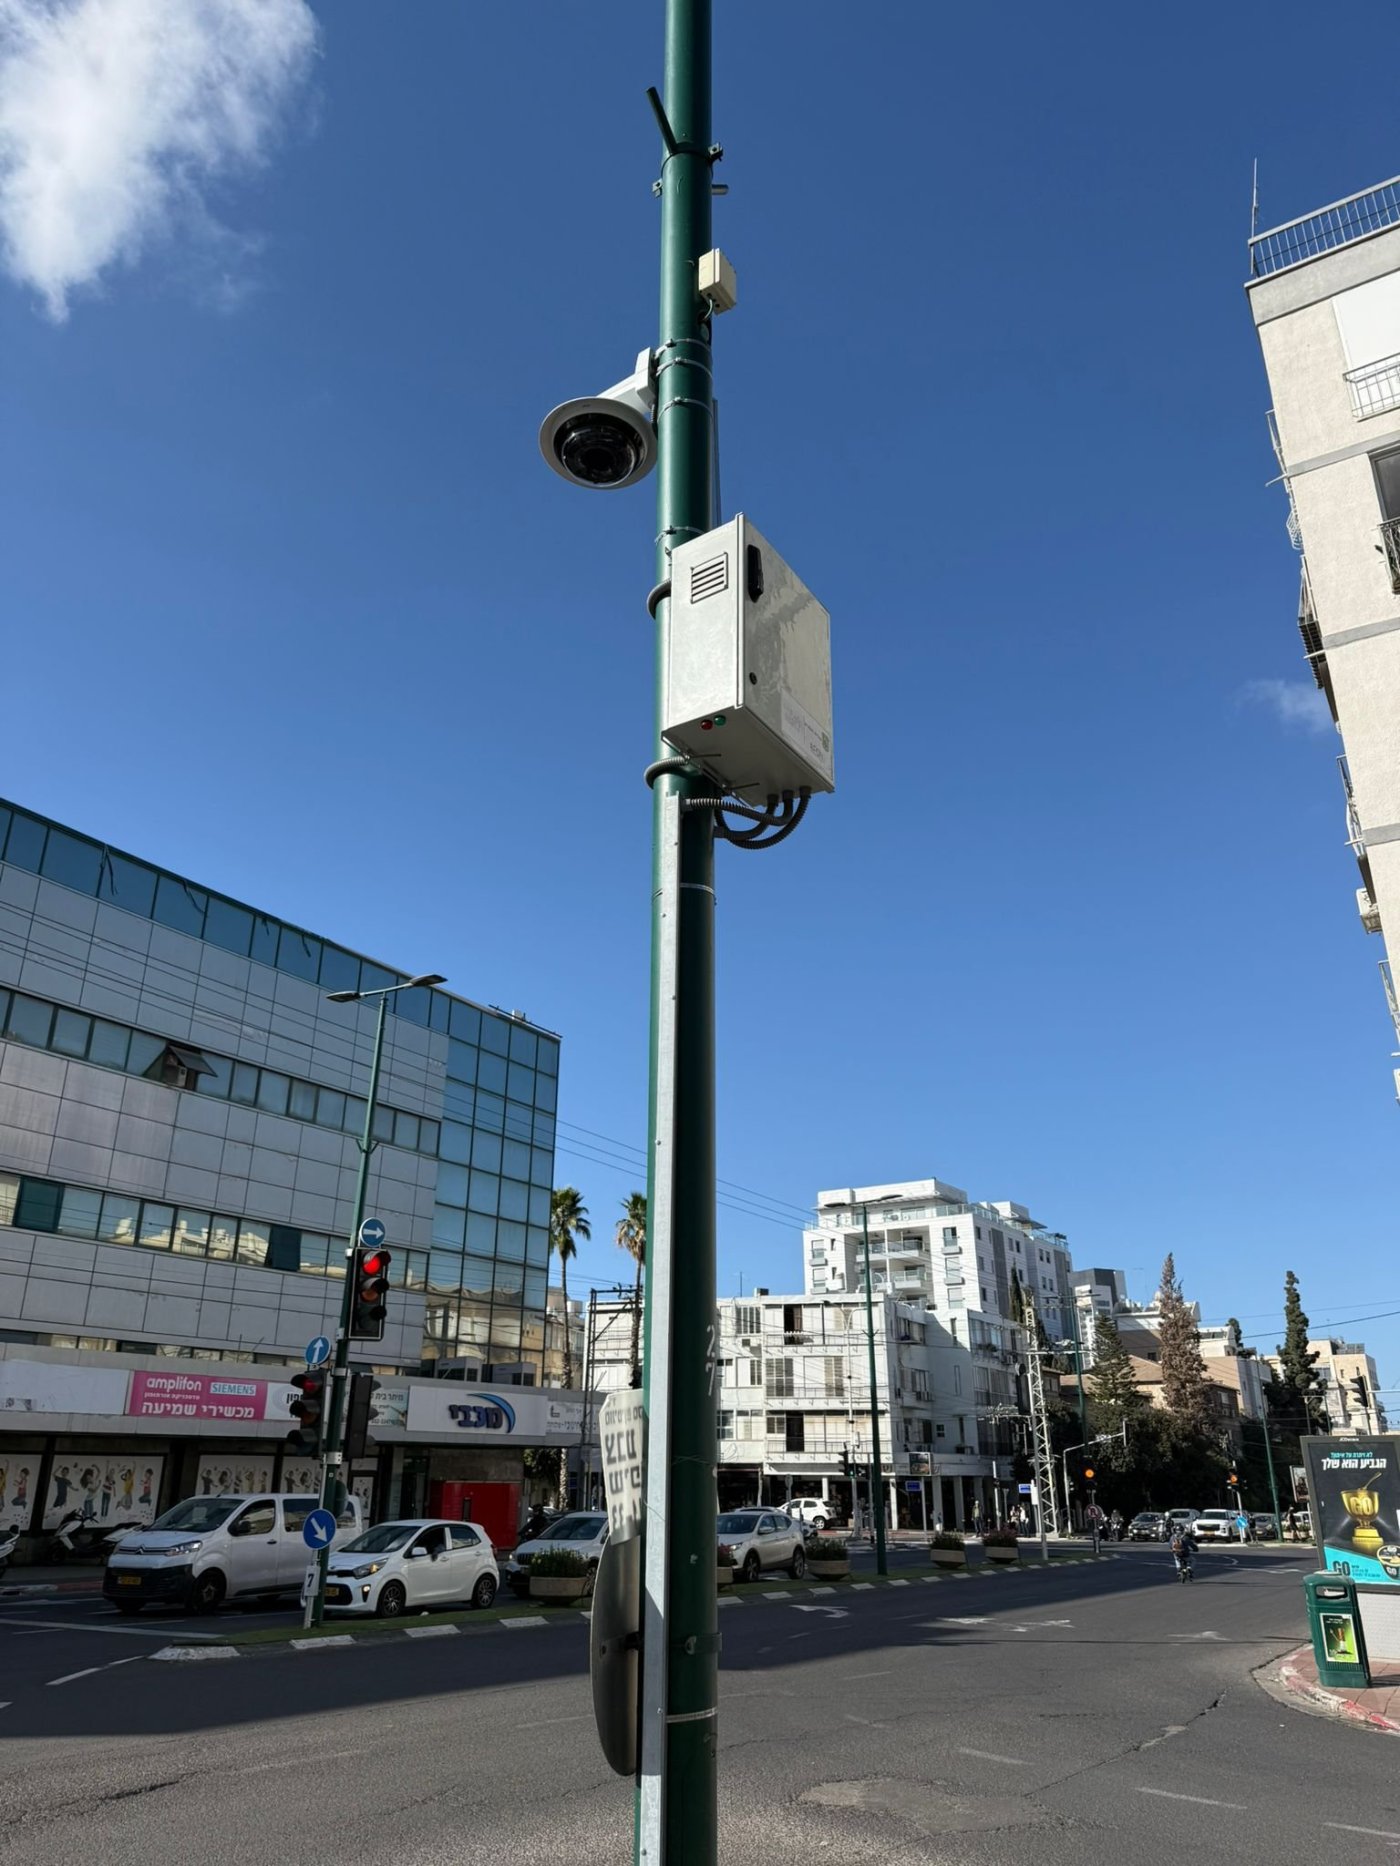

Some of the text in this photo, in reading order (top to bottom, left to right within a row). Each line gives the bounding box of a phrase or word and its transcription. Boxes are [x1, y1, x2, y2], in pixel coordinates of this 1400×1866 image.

[146, 1376, 202, 1393] amplifon
[211, 1383, 255, 1395] SIEMENS
[141, 1402, 255, 1418] מכשירי שמיעה
[448, 1404, 504, 1429] מכבי
[1321, 1457, 1387, 1471] הגביע הוא שלך
[1349, 1496, 1374, 1516] GO
[1333, 1561, 1350, 1576] GO
[307, 1573, 315, 1588] 7
